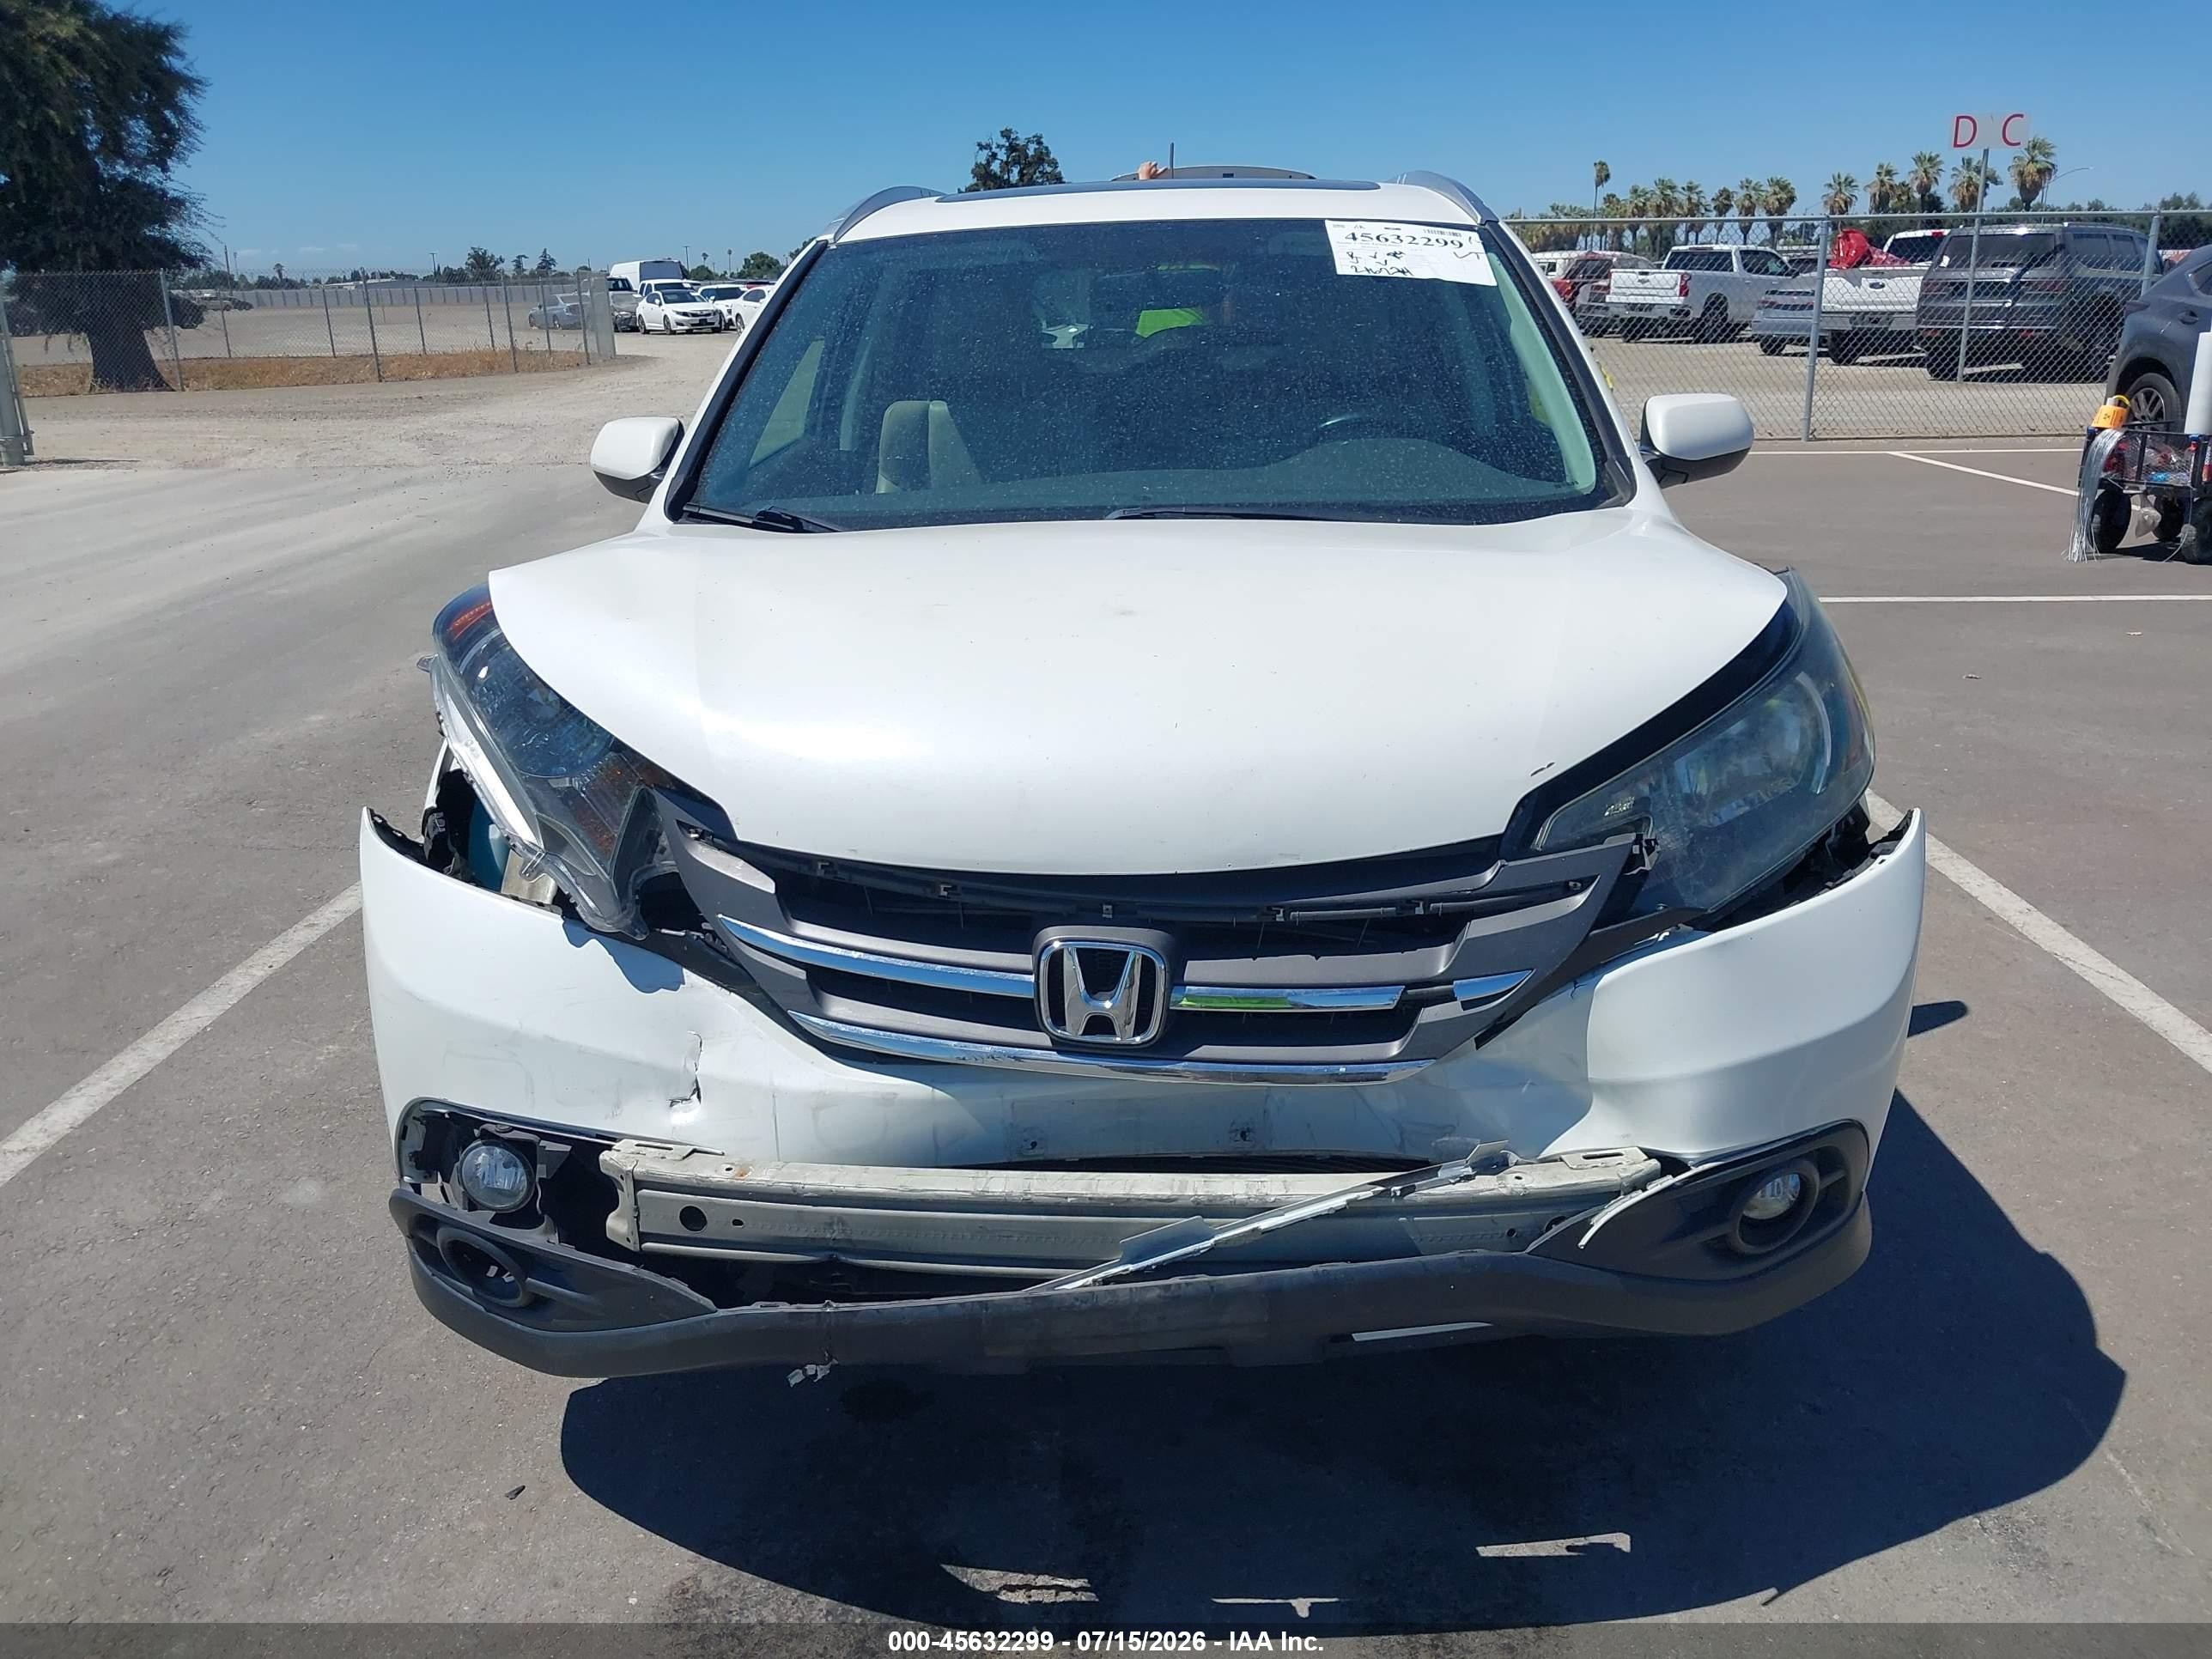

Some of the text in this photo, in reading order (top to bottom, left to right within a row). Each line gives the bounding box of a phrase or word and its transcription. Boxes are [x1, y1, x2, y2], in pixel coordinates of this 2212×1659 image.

[1953, 113, 2025, 148] D C
[1345, 231, 1464, 249] 45632299
